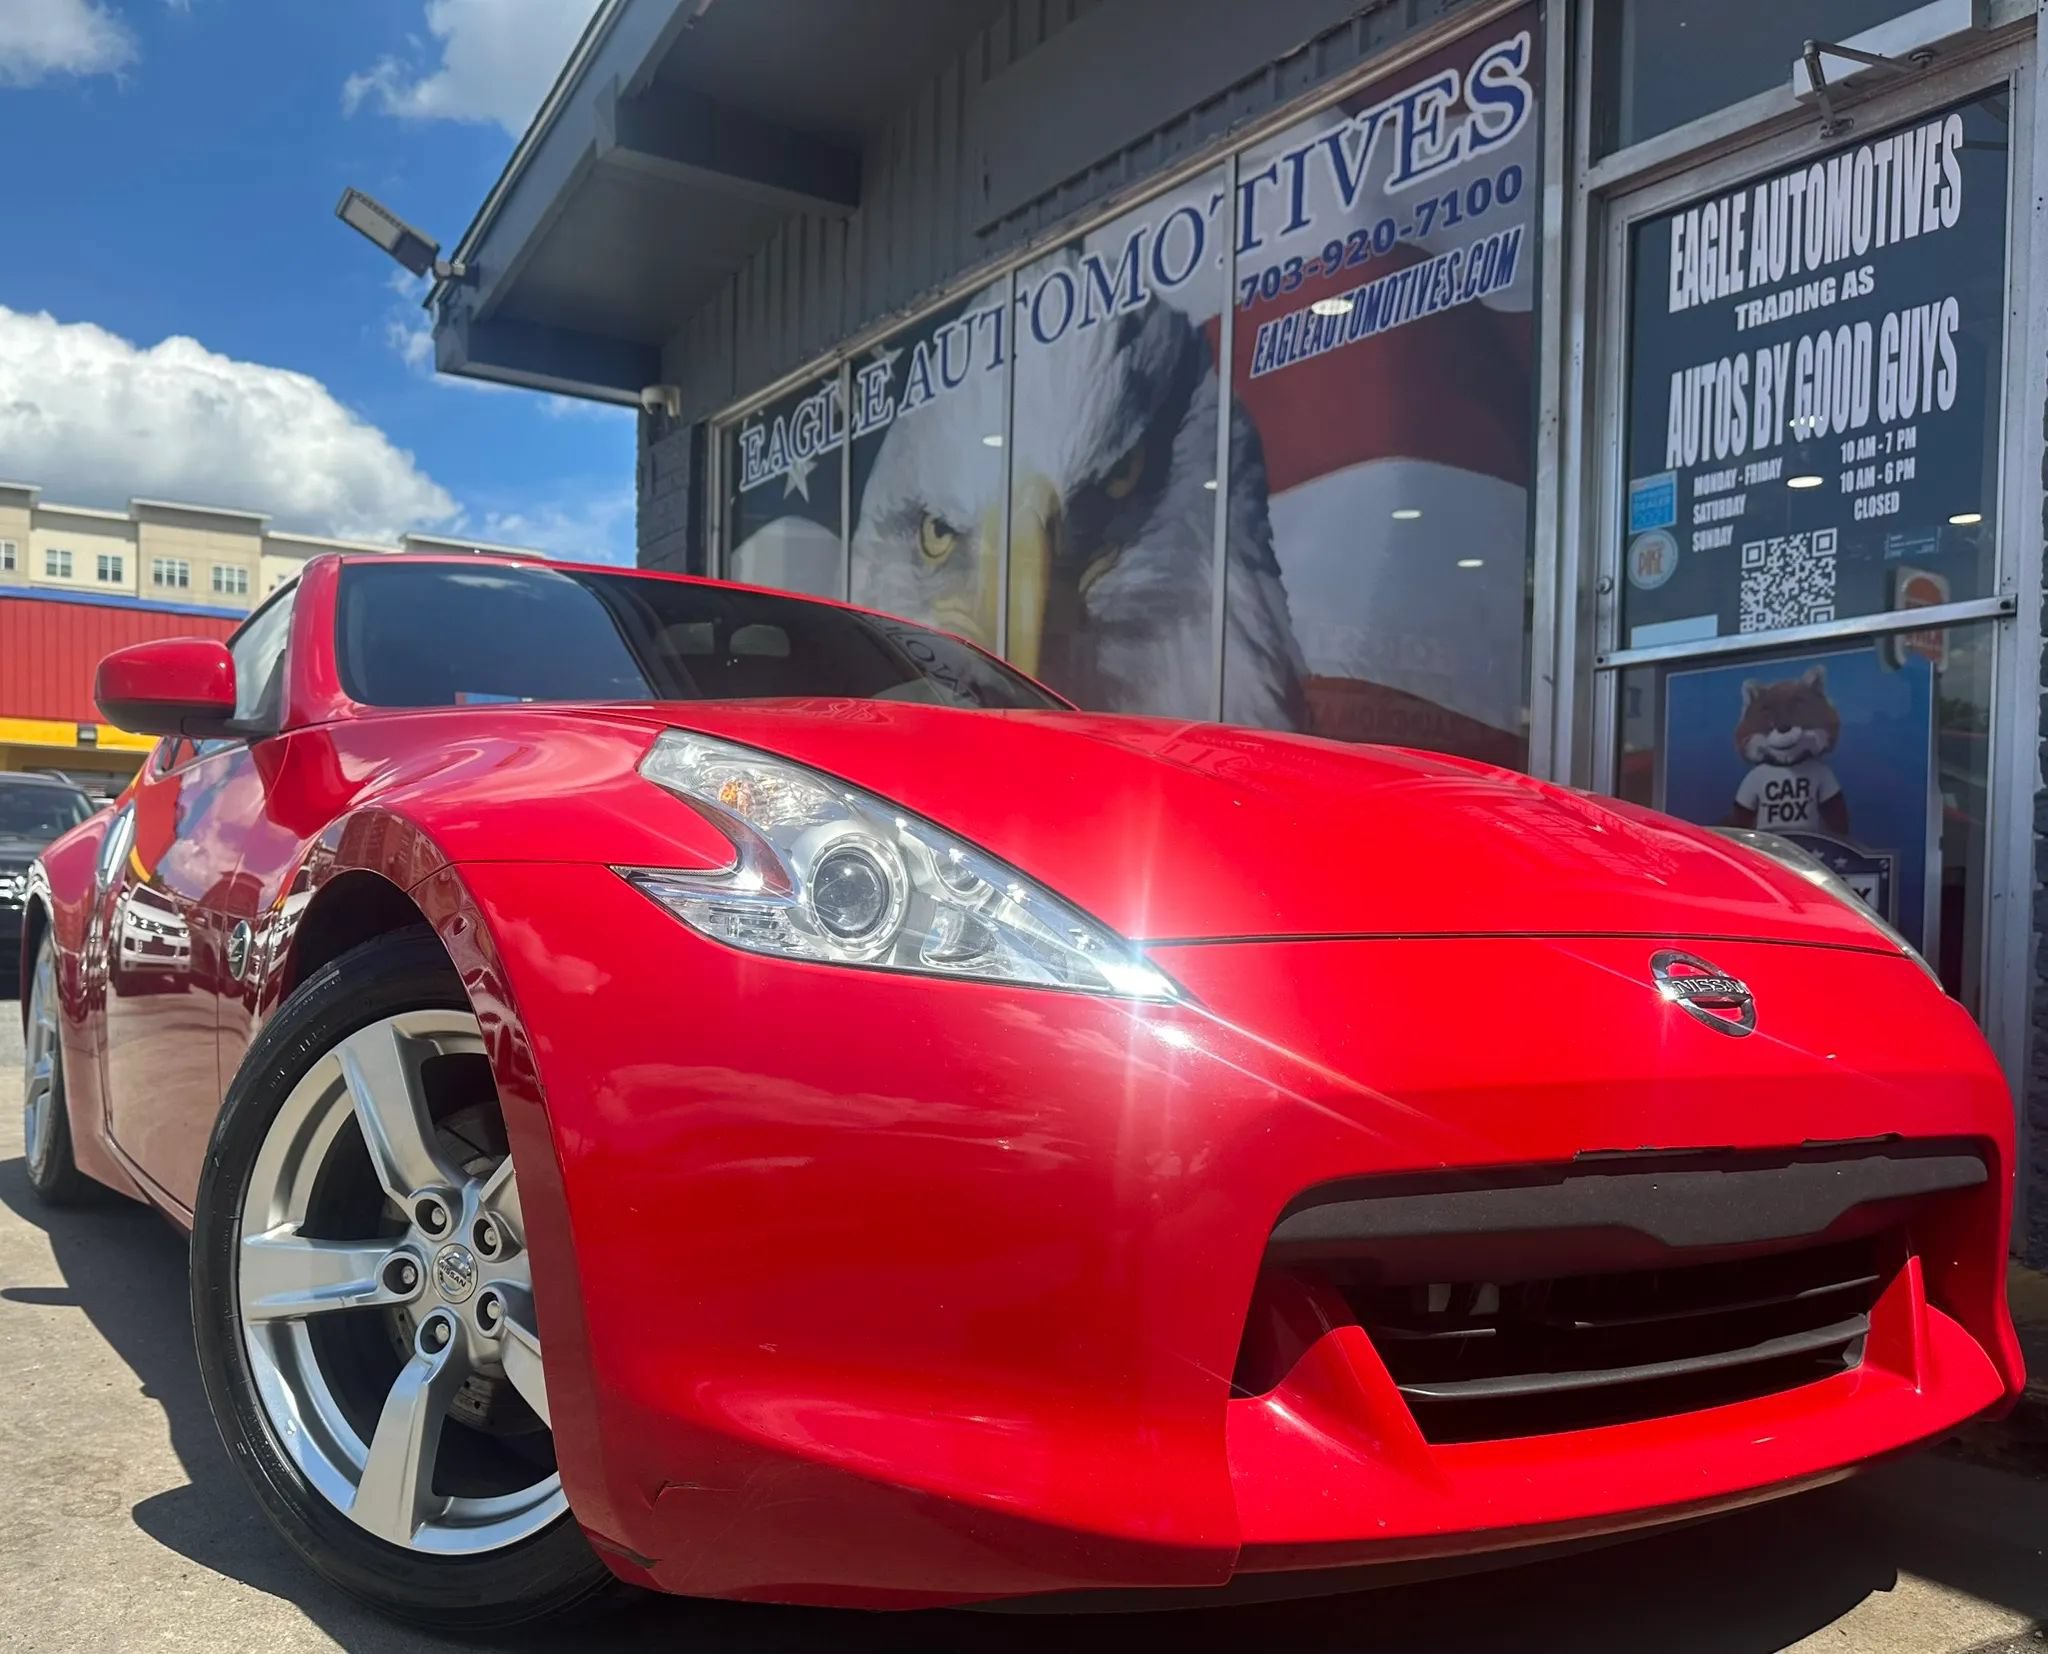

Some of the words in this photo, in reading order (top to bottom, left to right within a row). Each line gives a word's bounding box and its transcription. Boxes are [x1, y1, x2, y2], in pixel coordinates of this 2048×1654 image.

[1669, 191, 1746, 313] EAGLE
[1749, 114, 1963, 288] AUTOMOTIVES
[1240, 165, 1522, 310] 703-920-7100
[740, 360, 894, 491] EAGLE
[898, 32, 1531, 417] AUTOMOTIVES
[1250, 224, 1525, 378] EAGLEAUTOMOTIVES.COM
[1735, 277, 1836, 331] TRADING
[1841, 265, 1874, 300] AS
[1666, 352, 1749, 470] AUTOS
[1753, 342, 1791, 451] BY
[1794, 321, 1873, 443] GOOD
[1877, 296, 1959, 424] GUYS
[1841, 439, 1855, 464] 10
[1856, 435, 1876, 461] AM
[1885, 432, 1892, 454] 7
[1897, 426, 1917, 451] PM
[1694, 468, 1738, 497] MONDAY
[1745, 457, 1783, 486] FRIDAY
[1840, 470, 1854, 493] 10
[1856, 465, 1875, 490] AM
[1884, 461, 1894, 484] 6
[1895, 457, 1916, 482] PM
[1693, 494, 1746, 524] SATURDAY
[1854, 491, 1899, 521] CLOSED
[1692, 525, 1734, 552] SUNDAY
[1765, 777, 1810, 802] CAR
[1766, 800, 1809, 825] FOX
[1671, 977, 1751, 996] NISSAN
[439, 1260, 467, 1288] NISSAN
